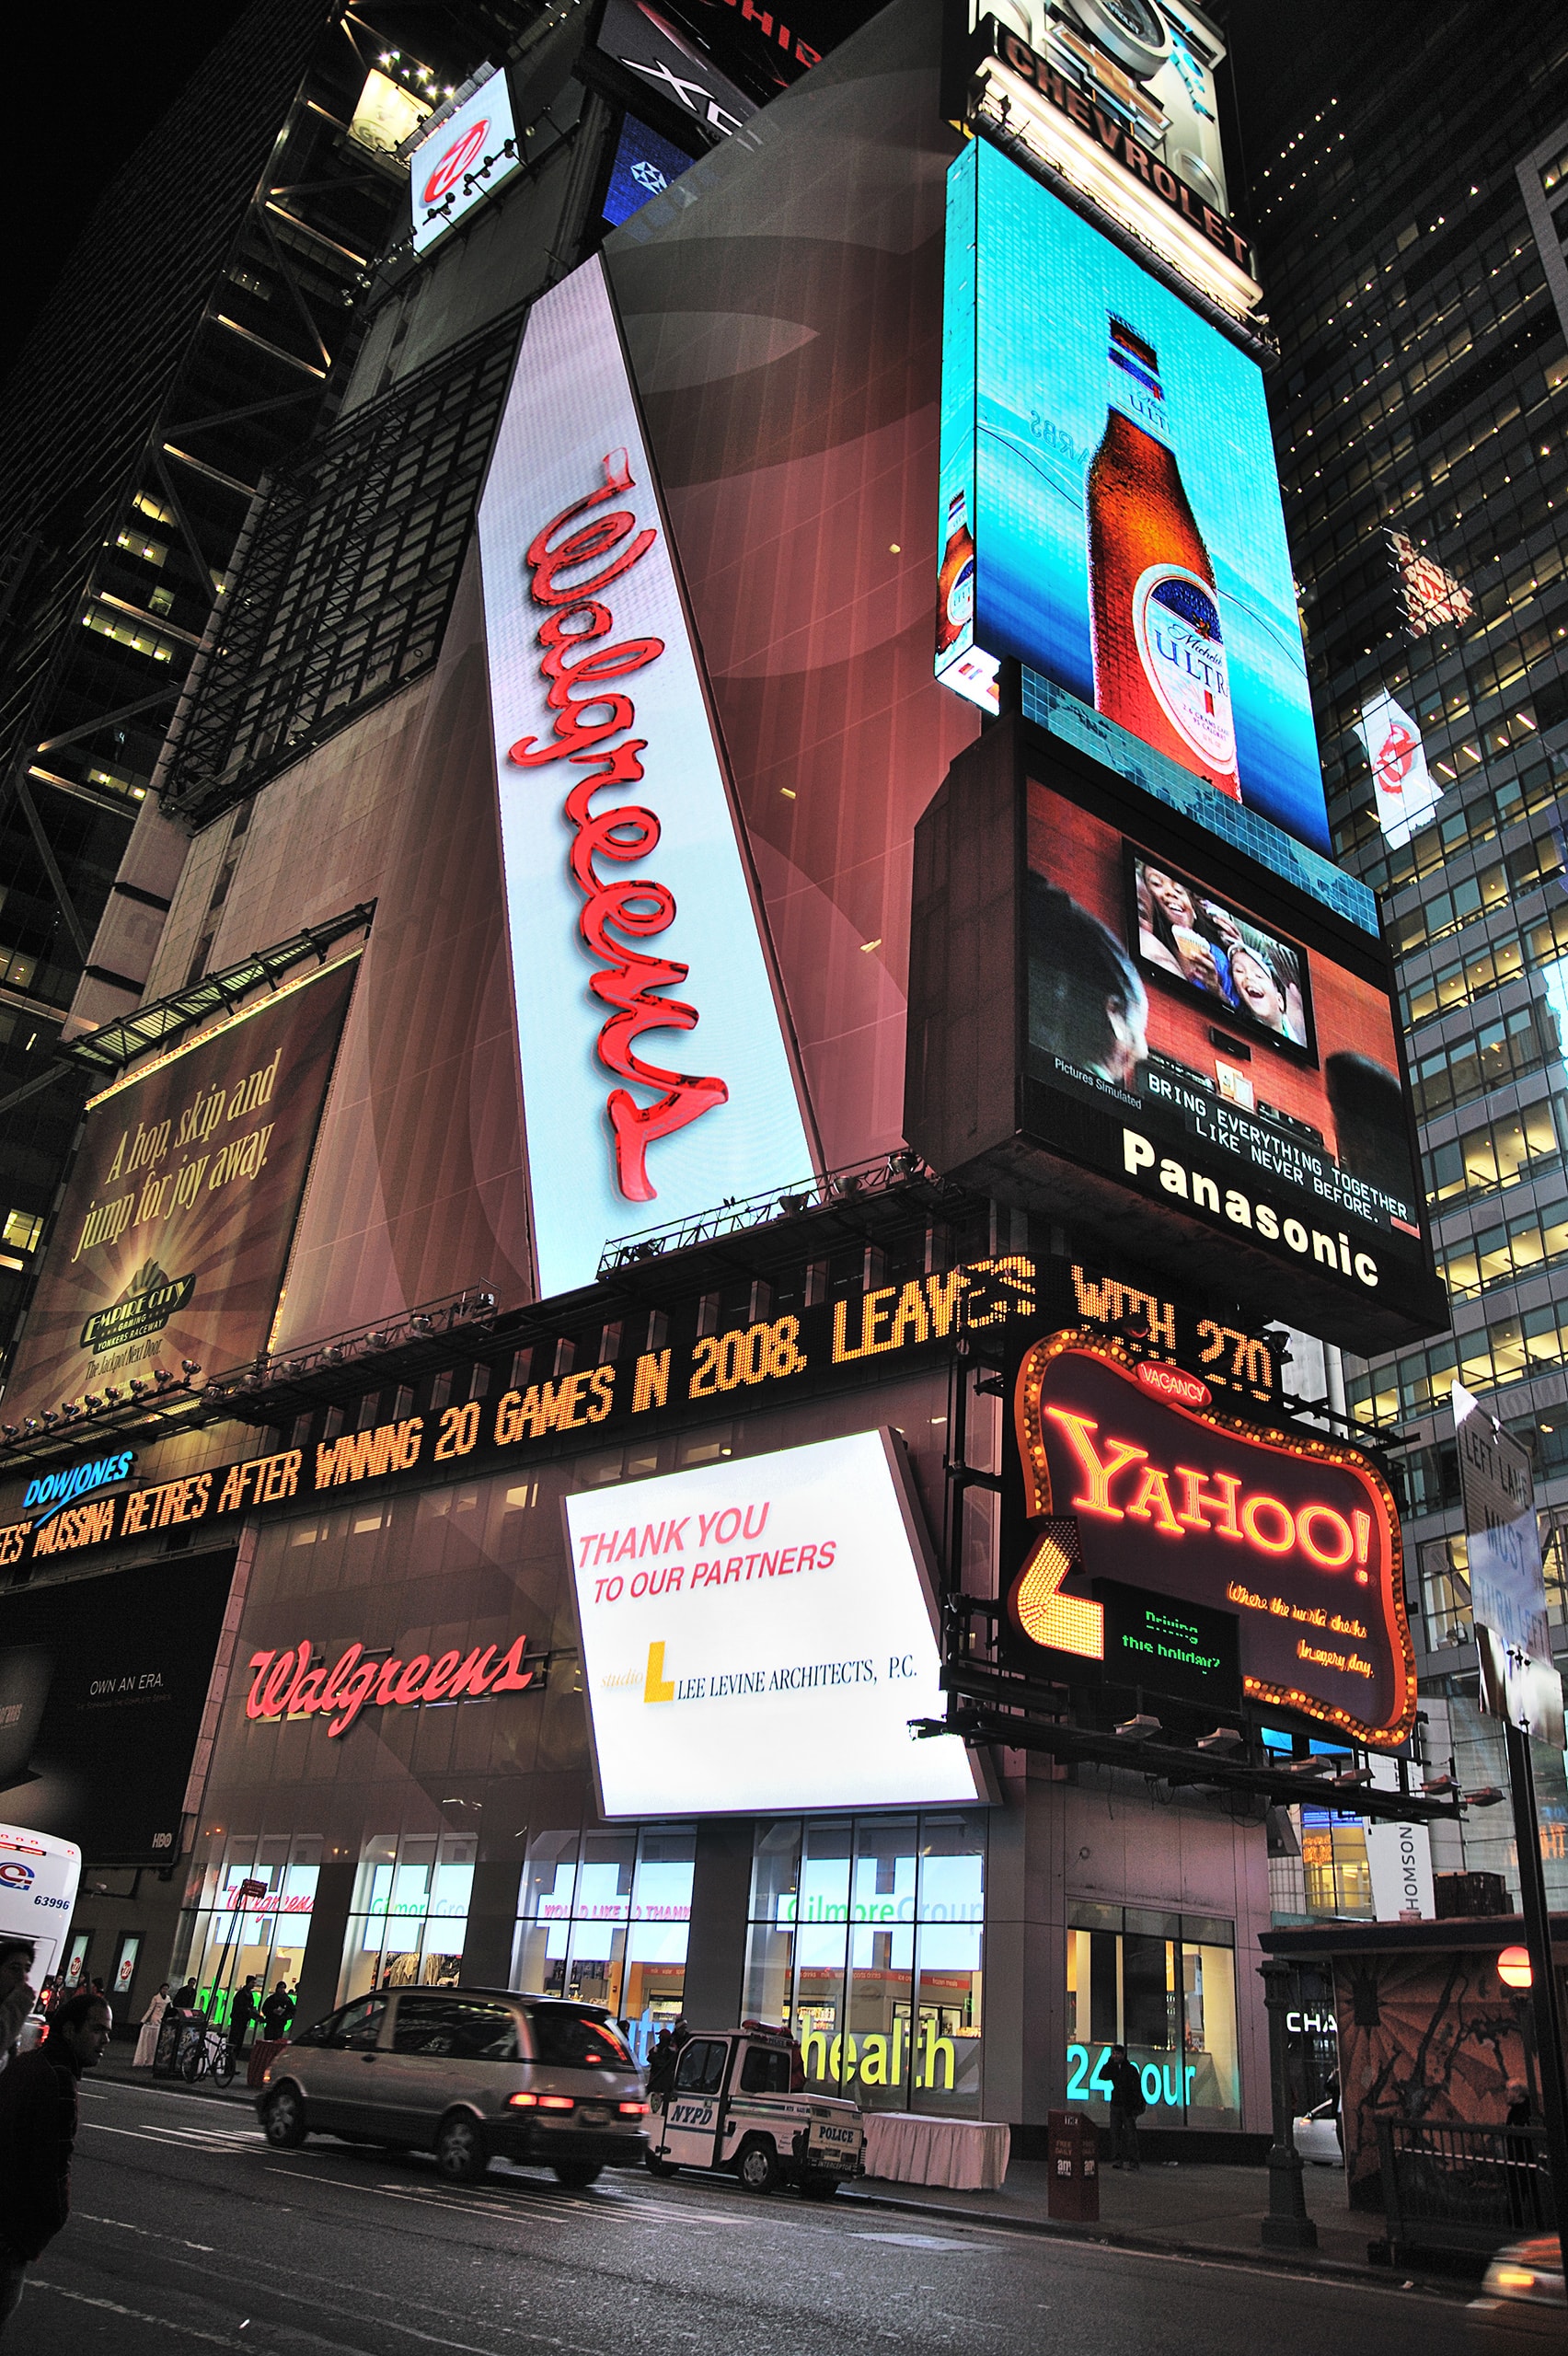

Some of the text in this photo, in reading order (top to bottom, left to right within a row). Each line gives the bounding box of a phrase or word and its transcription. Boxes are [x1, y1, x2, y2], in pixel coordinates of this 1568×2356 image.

[1005, 34, 1250, 267] CHEVROLET
[507, 447, 730, 1204] Walgreens
[104, 1046, 282, 1185] A hop, skip and
[1055, 1057, 1143, 1111] Pictures Simulated
[1147, 1072, 1408, 1220] BRING EVERYTHING TOGETHER
[1195, 1116, 1380, 1224] LIKE NEVER BEFORE.
[71, 1122, 276, 1264] jump for joy away.
[1122, 1126, 1379, 1288] Panasonic
[84, 1276, 192, 1344] EMPIRE CITY
[97, 1318, 164, 1351] YONKERS RACEWAY
[120, 1472, 213, 1537] RETIRES
[216, 1448, 304, 1514] AFTER
[434, 1402, 482, 1462] 20
[494, 1364, 617, 1447] GAMES
[632, 1348, 672, 1414] IN
[832, 1254, 1037, 1364] LEAVES
[1140, 1362, 1205, 1403] VACANCY
[1044, 1404, 1372, 1585] YAHOO!
[1464, 1425, 1528, 1509] LEFT LANE
[578, 1501, 771, 1569] THANK YOU
[1484, 1505, 1526, 1576] MUST
[594, 1540, 837, 1604] TO OUR PARTNERS
[1227, 1580, 1367, 1639] Where the world checks
[1477, 1576, 1544, 1654] TURN LEFT
[89, 1672, 165, 1696] OWN AN ERA.
[246, 1634, 534, 1738] Walgreens
[601, 1668, 644, 1688] studio
[676, 1677, 707, 1701] LEE
[709, 1671, 766, 1698] LEVINE
[768, 1658, 879, 1692] ARCHITECTS,
[888, 1654, 918, 1680] P.C.
[152, 1832, 173, 1849] HBO
[1399, 1826, 1420, 1911] HOMSON
[33, 1895, 71, 1911] 63996
[592, 1904, 621, 1920] LIKE
[1066, 2043, 1115, 2103] 24
[670, 2105, 713, 2126] NYPD
[818, 2125, 854, 2144] POLICE
